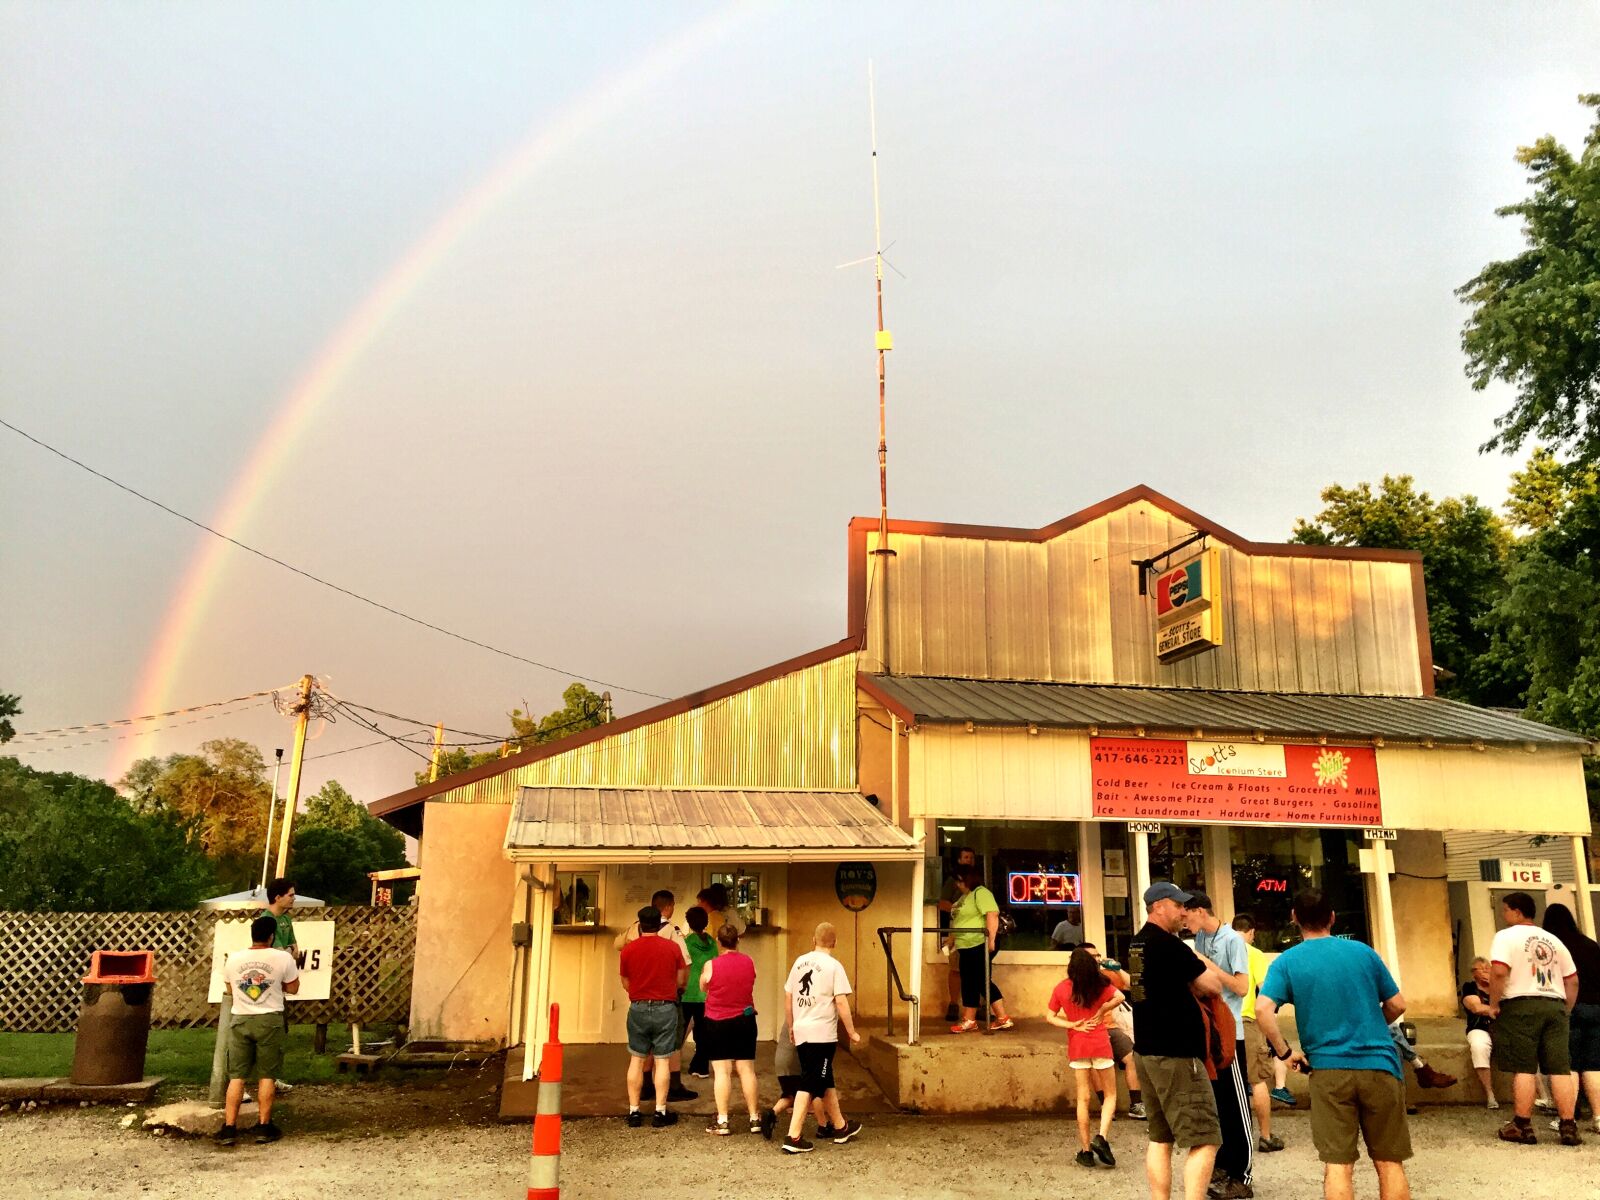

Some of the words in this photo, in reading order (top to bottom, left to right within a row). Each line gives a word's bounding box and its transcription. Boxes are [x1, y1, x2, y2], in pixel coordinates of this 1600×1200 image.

[1169, 580, 1189, 597] PEPSI
[1168, 621, 1190, 637] SCOTT'S
[1158, 635, 1181, 653] GENERAL
[1182, 626, 1202, 643] STORE
[1095, 753, 1184, 766] 417-646-2221
[1189, 744, 1237, 774] Scott's
[1320, 754, 1344, 776] Nehi
[1217, 766, 1255, 776] Iconium
[1257, 767, 1283, 777] Store
[1096, 778, 1121, 788] Cold
[1124, 779, 1149, 789] Beer
[1171, 780, 1186, 790] Ice
[1190, 781, 1223, 791] Cream
[1227, 782, 1235, 791] &
[1238, 783, 1270, 793] Floats
[1288, 785, 1338, 795] Groceries
[1355, 787, 1377, 796] Milk
[1096, 791, 1119, 801] Bait
[1133, 793, 1183, 803] Awesome
[1186, 794, 1214, 804] Pizza
[1240, 796, 1270, 806] Great
[1273, 797, 1314, 809] Burgers
[1333, 800, 1379, 809] Gasoline
[1097, 805, 1114, 815] Ice
[1134, 807, 1201, 817] Laundromat
[1219, 809, 1271, 819] Hardware
[1286, 811, 1316, 821] Home
[1319, 812, 1380, 824] Furnishings
[1129, 822, 1160, 832] HONOR
[1366, 829, 1396, 839] THINK
[840, 870, 874, 880] ROY'S
[1512, 870, 1542, 882] ICE
[1010, 874, 1079, 902] OPEN
[1256, 879, 1287, 892] ATM
[295, 949, 321, 970] WS
